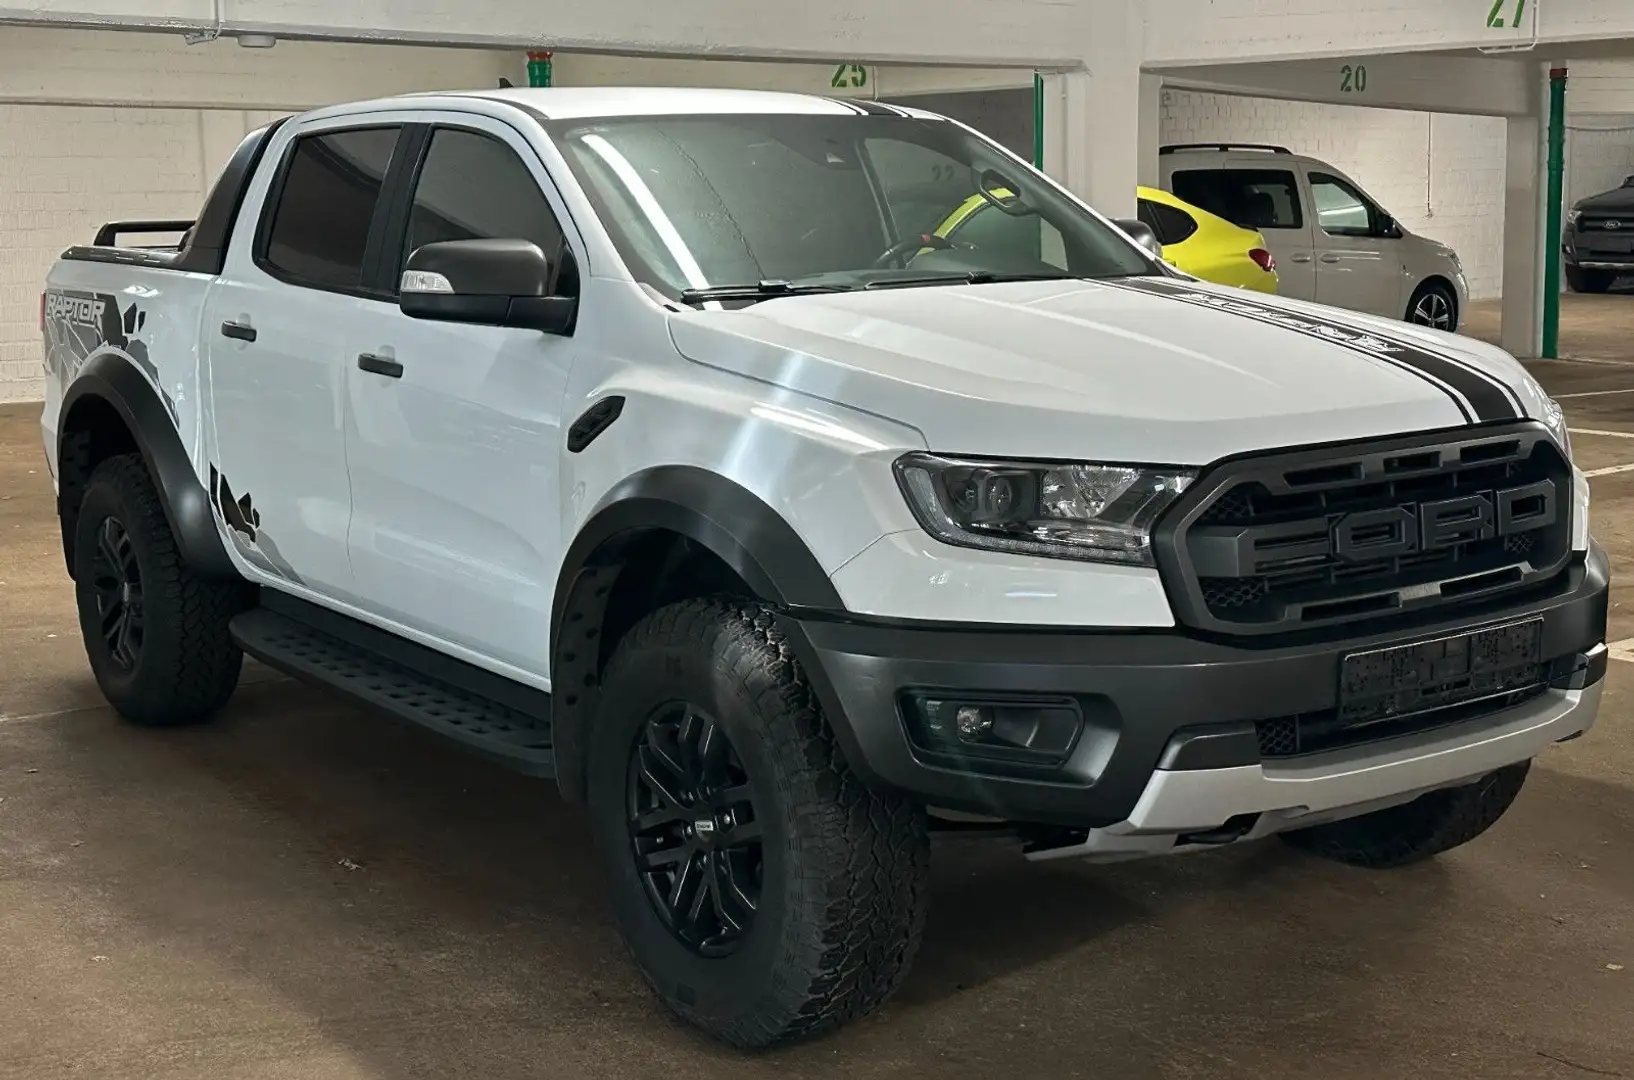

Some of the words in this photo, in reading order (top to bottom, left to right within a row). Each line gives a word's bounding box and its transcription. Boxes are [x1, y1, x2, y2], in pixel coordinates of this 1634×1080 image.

[831, 64, 867, 88] 25
[1340, 65, 1366, 92] 20
[46, 293, 106, 324] RAPTOR
[1191, 478, 1558, 578] FORD
